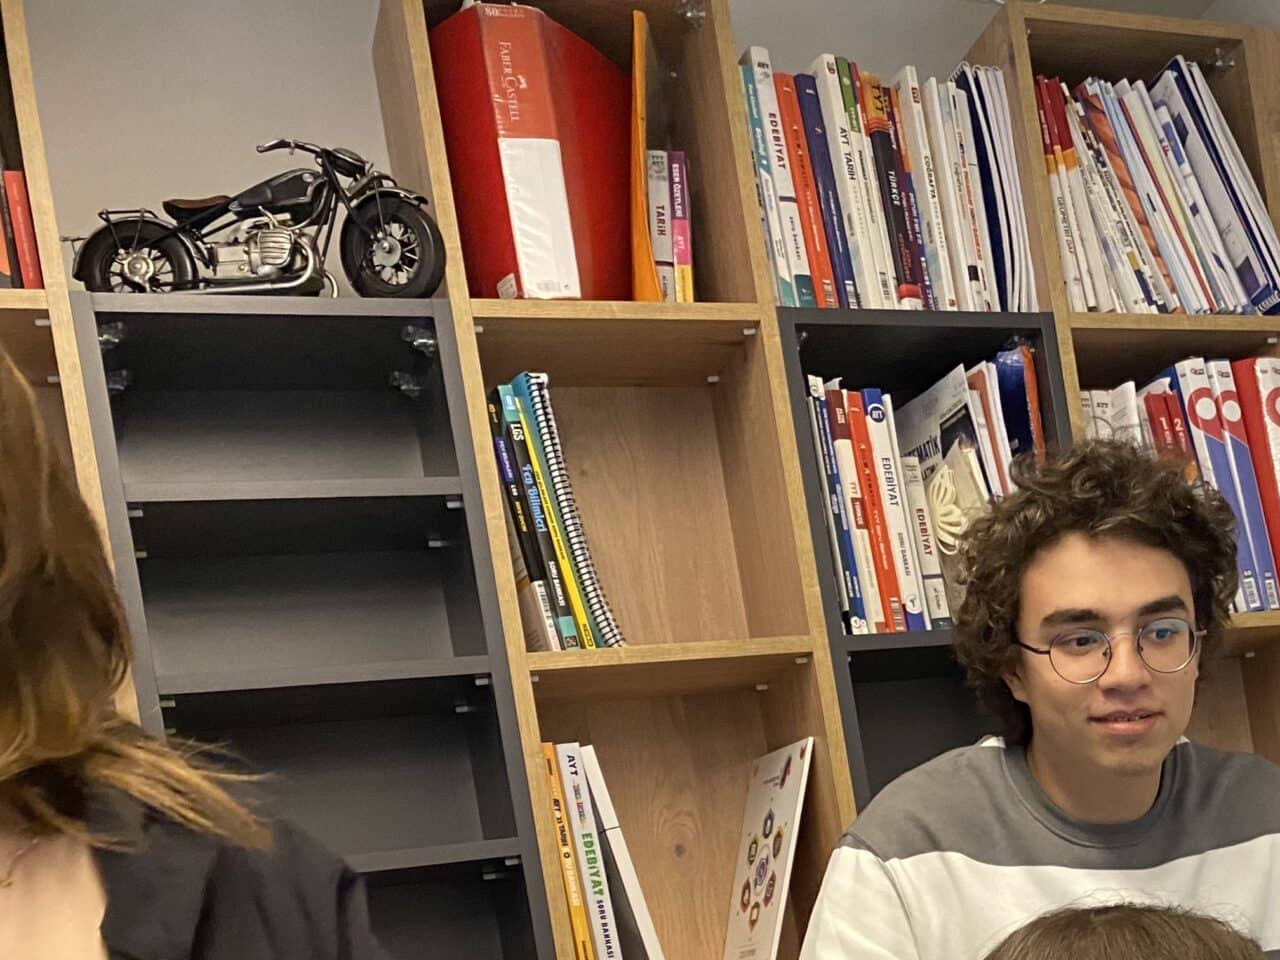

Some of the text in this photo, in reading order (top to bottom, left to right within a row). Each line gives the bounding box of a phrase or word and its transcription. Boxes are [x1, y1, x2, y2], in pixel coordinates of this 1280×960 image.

[499, 40, 521, 121] FABER CASTELL
[871, 83, 884, 114] TYT
[769, 112, 785, 170] EDEBİYAT
[839, 127, 849, 145] AYT
[887, 171, 900, 206] TÜRKÇE
[923, 156, 936, 199] COĞRAFYA
[657, 205, 665, 235] TARİH
[510, 423, 523, 441] LGS
[521, 465, 534, 484] Fen
[882, 458, 898, 507] EDEBİYAT
[527, 487, 548, 532] Bilimleri
[916, 509, 932, 555] EDEBİYAT
[553, 578, 566, 606] BANKASI
[567, 755, 614, 958] AYT EDEBİYAT SORU BANKASI
